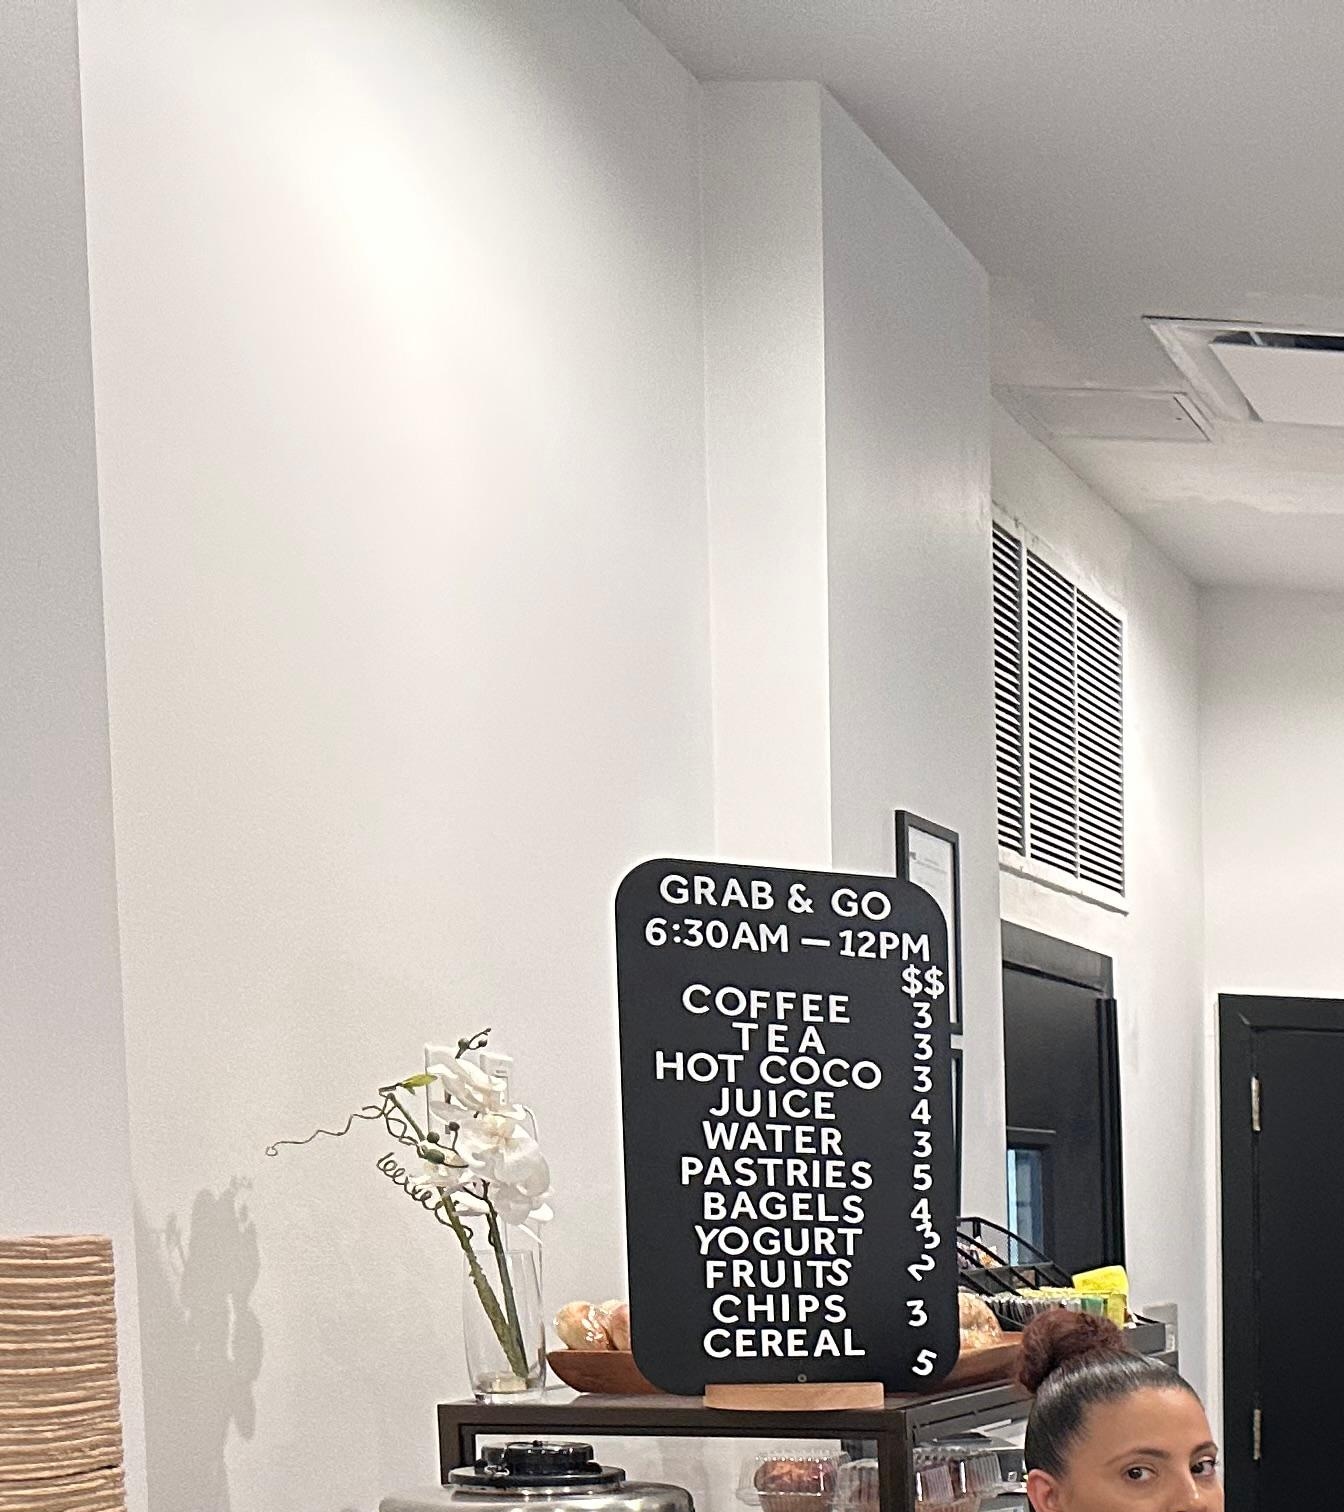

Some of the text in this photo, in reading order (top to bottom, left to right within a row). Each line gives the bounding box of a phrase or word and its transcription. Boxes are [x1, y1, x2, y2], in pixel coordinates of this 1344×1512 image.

[659, 875, 891, 921] GRAB & GO
[645, 918, 789, 953] 6:30AM
[839, 930, 930, 962] 12PM
[902, 964, 945, 999] $$
[682, 984, 932, 1029] COFFEE 3
[731, 1022, 933, 1060] TEA 3
[656, 1051, 932, 1093] HOT COCO 3
[709, 1088, 932, 1125] JUICE 4
[702, 1121, 932, 1158] WATER 3
[681, 1157, 933, 1191] PASTRIES 5
[704, 1191, 932, 1226] BAGELS 4
[695, 1223, 940, 1257] YOGURT 3
[707, 1254, 936, 1289] FRUITS 2
[713, 1293, 927, 1326] CHIPS 3
[703, 1328, 937, 1376] CEREAL 5
